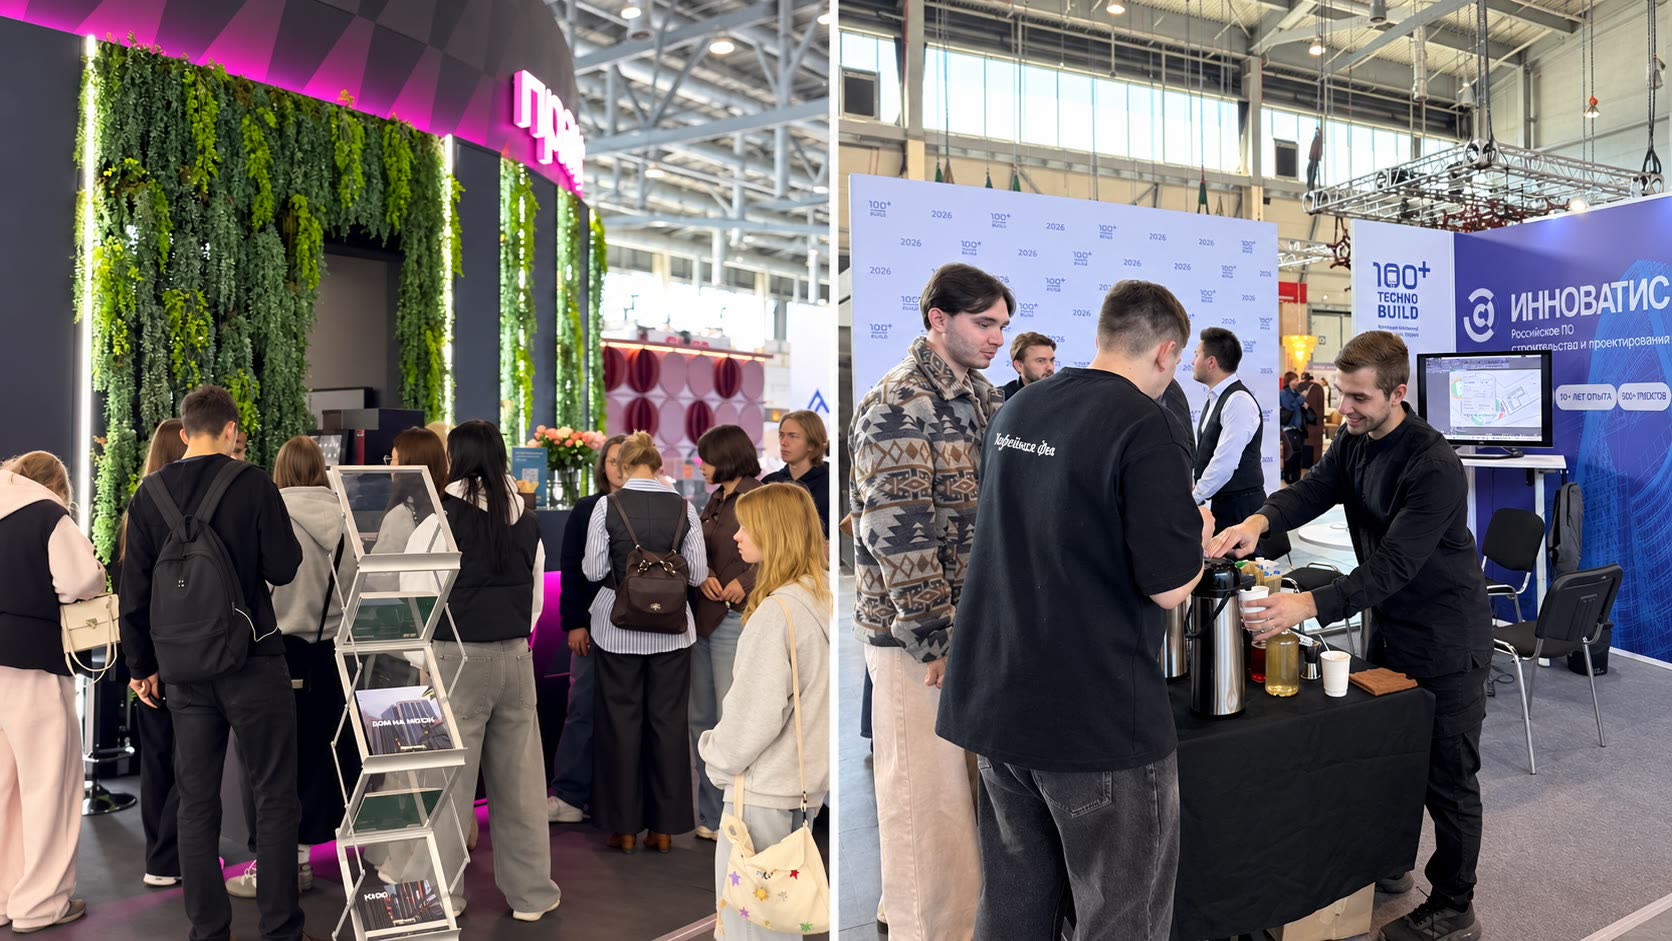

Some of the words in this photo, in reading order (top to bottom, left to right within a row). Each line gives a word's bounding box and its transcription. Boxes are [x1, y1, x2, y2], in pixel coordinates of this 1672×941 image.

[931, 210, 953, 219] 2026
[1045, 223, 1065, 231] 2026
[1149, 233, 1167, 241] 2026
[900, 238, 922, 247] 2026
[1198, 238, 1215, 246] 2026
[1018, 249, 1038, 257] 2026
[1123, 259, 1142, 267] 2026
[1174, 263, 1192, 271] 2026
[869, 267, 892, 275] 2026
[1373, 261, 1431, 290] 100+
[1377, 291, 1418, 304] TECHNO
[1511, 275, 1670, 322] ИННОВАТИС
[1072, 309, 1091, 317] 2026
[1378, 305, 1418, 320] BUILD
[869, 323, 893, 332] 100+
[1511, 327, 1560, 339] Российское
[1561, 324, 1574, 335] ПО
[1580, 341, 1587, 349] и
[1573, 393, 1585, 401] ЛЕТ
